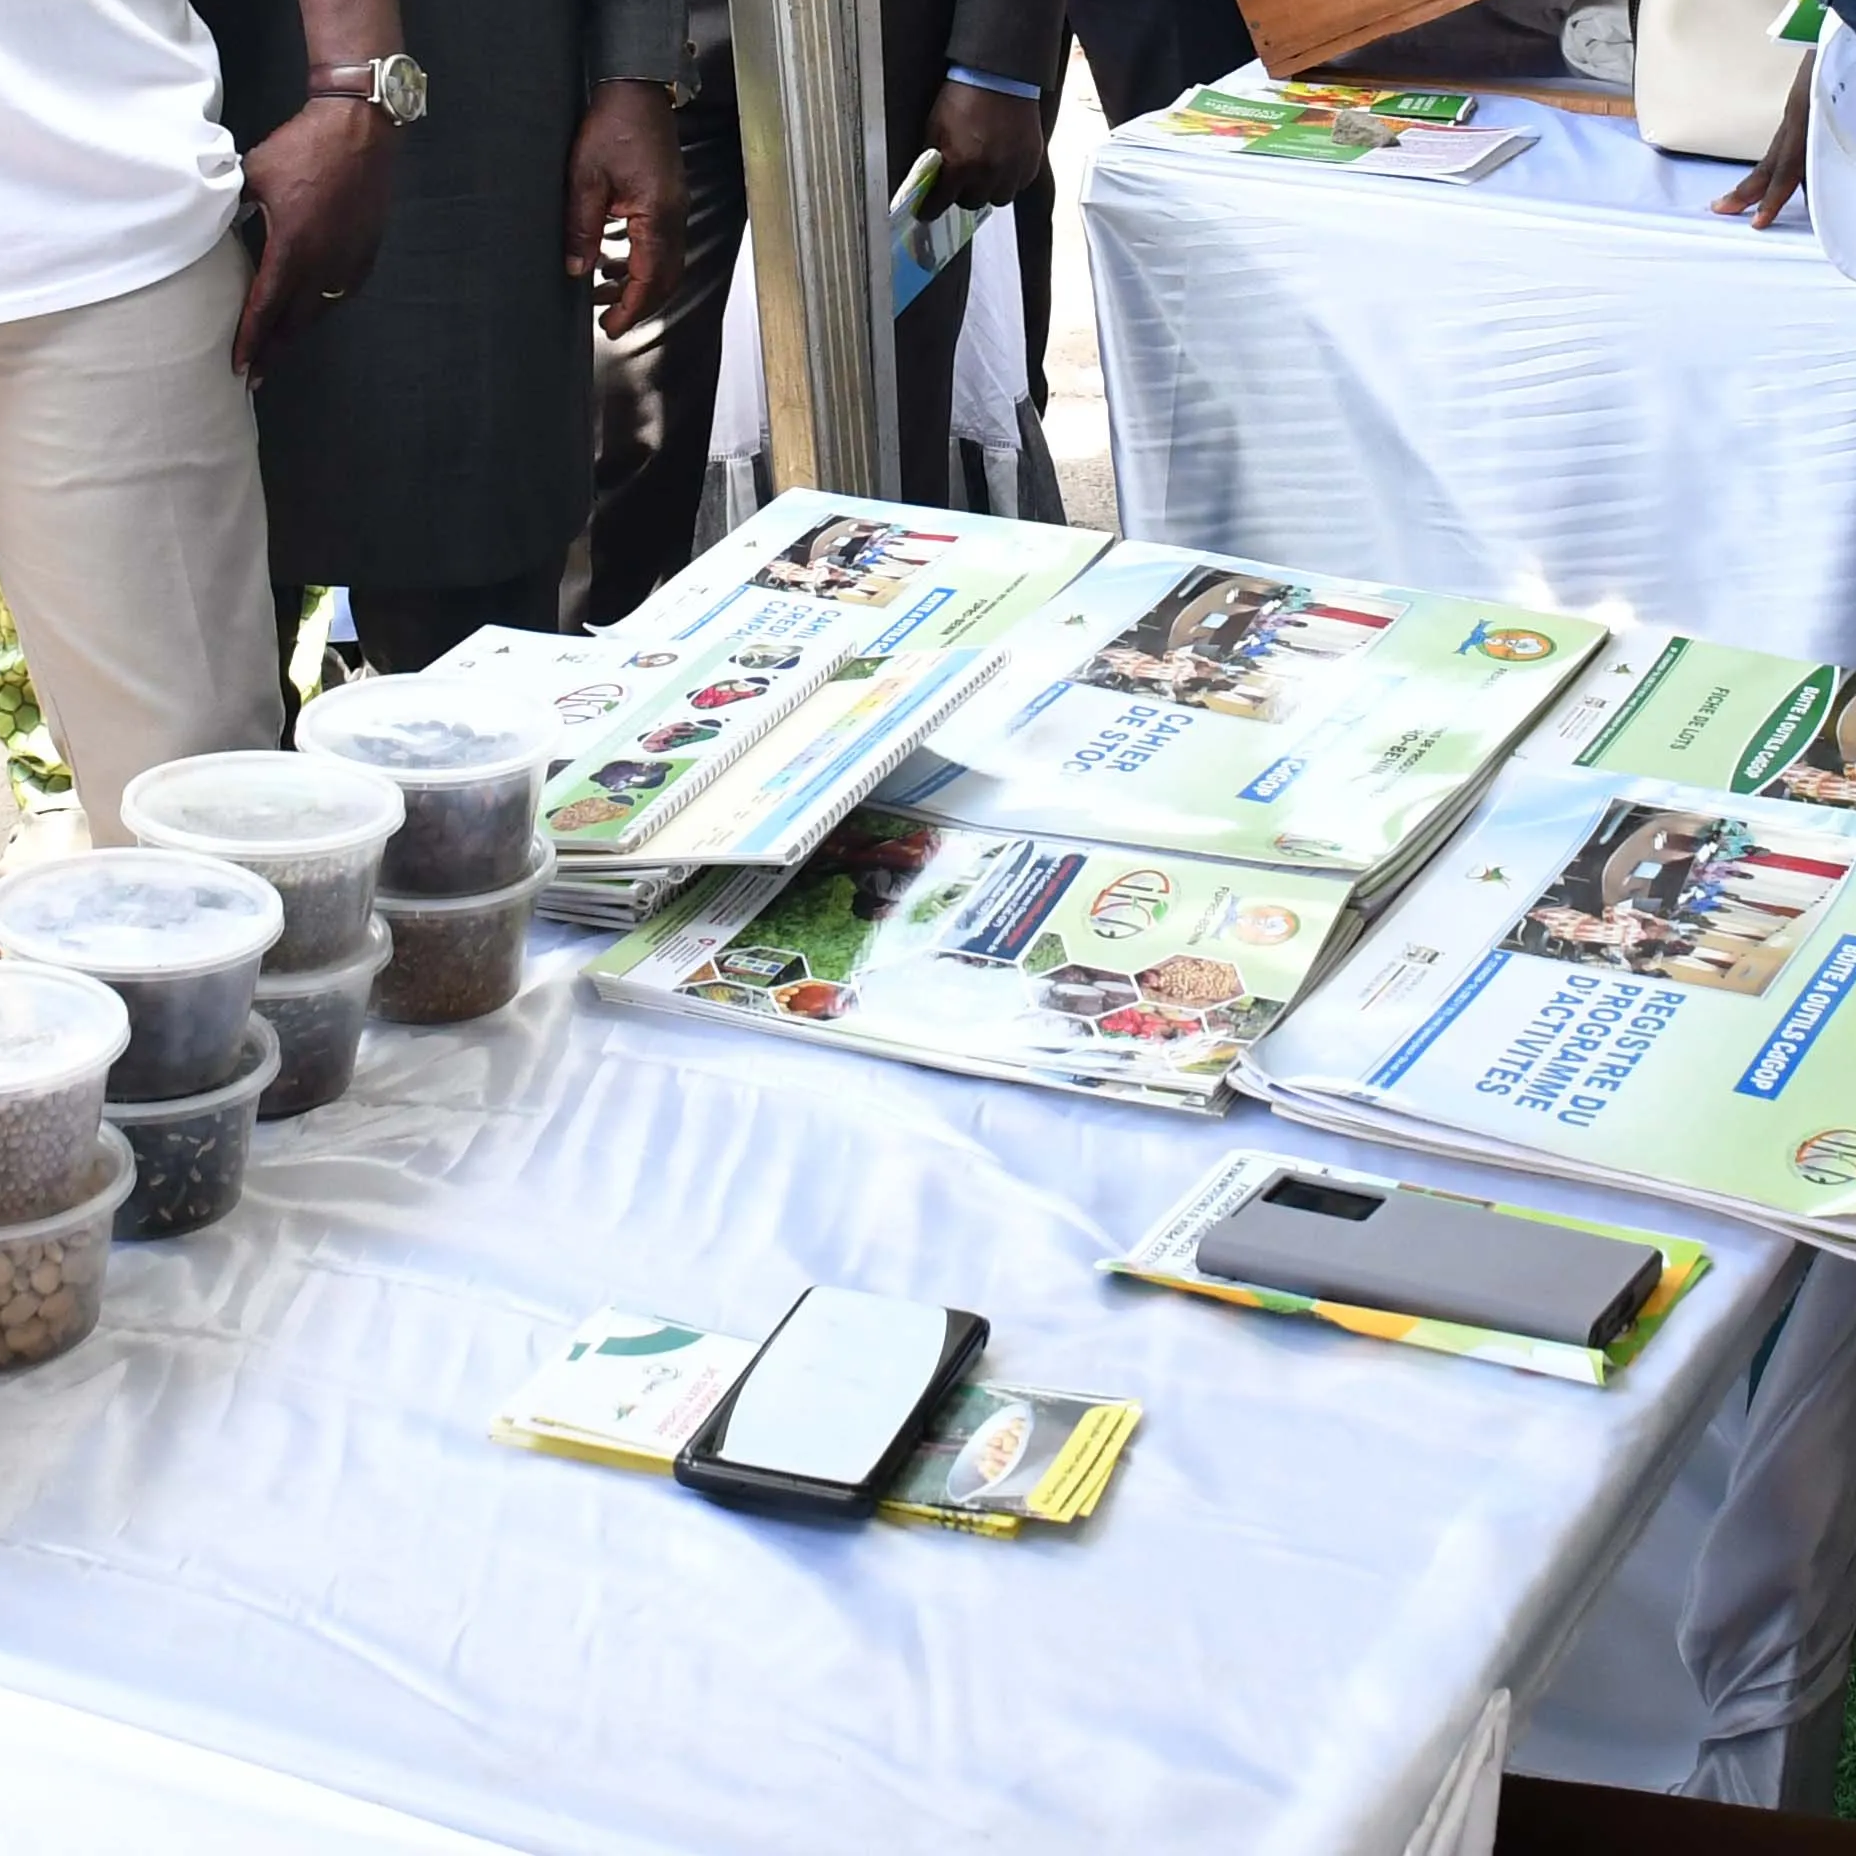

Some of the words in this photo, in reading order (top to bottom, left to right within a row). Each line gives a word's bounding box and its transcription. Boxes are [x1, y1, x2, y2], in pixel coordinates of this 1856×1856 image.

[1114, 704, 1160, 728] DE
[1699, 686, 1731, 716] FICHE
[1060, 729, 1130, 777] STOC
[1104, 713, 1194, 773] CAHIER
[1670, 725, 1700, 752] LOTS
[1813, 980, 1839, 993] A
[1781, 992, 1832, 1042] OUTILS
[1513, 981, 1644, 1112] PROGRAMME
[1582, 989, 1688, 1093] REGISTRE
[1557, 1093, 1608, 1128] DU
